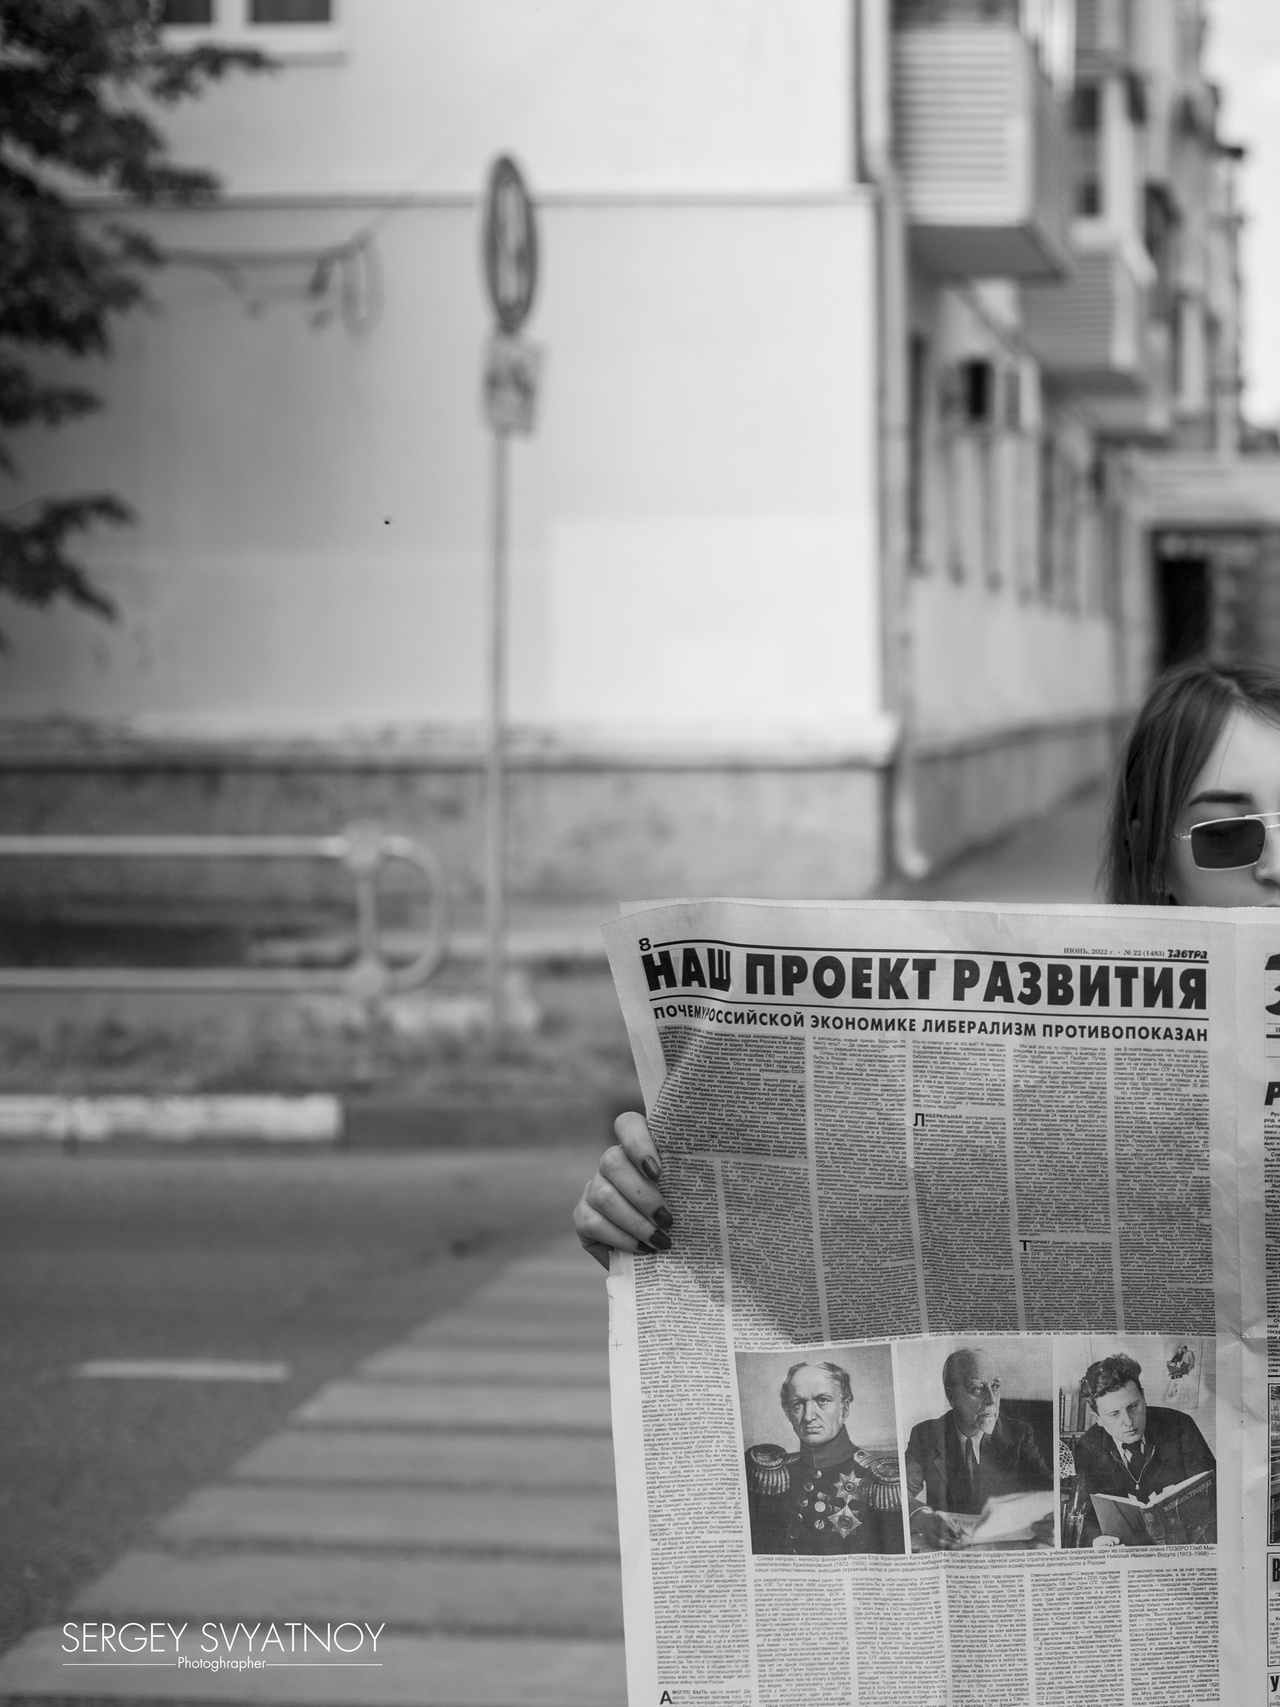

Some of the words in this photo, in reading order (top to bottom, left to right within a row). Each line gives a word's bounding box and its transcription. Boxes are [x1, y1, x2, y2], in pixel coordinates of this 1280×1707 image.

[639, 938, 651, 951] 8
[641, 948, 730, 992] НАШ
[746, 953, 936, 1000] ПРОЕКТ
[953, 959, 1206, 1010] РАЗВИТИЯ
[811, 1016, 916, 1032] ЭКОНОМИКЕ
[922, 1019, 1036, 1036] ЛИБЕРАЛИЗМ
[1042, 1024, 1208, 1042] ПРОТИВОПОКАЗАН
[660, 1691, 673, 1705] А
